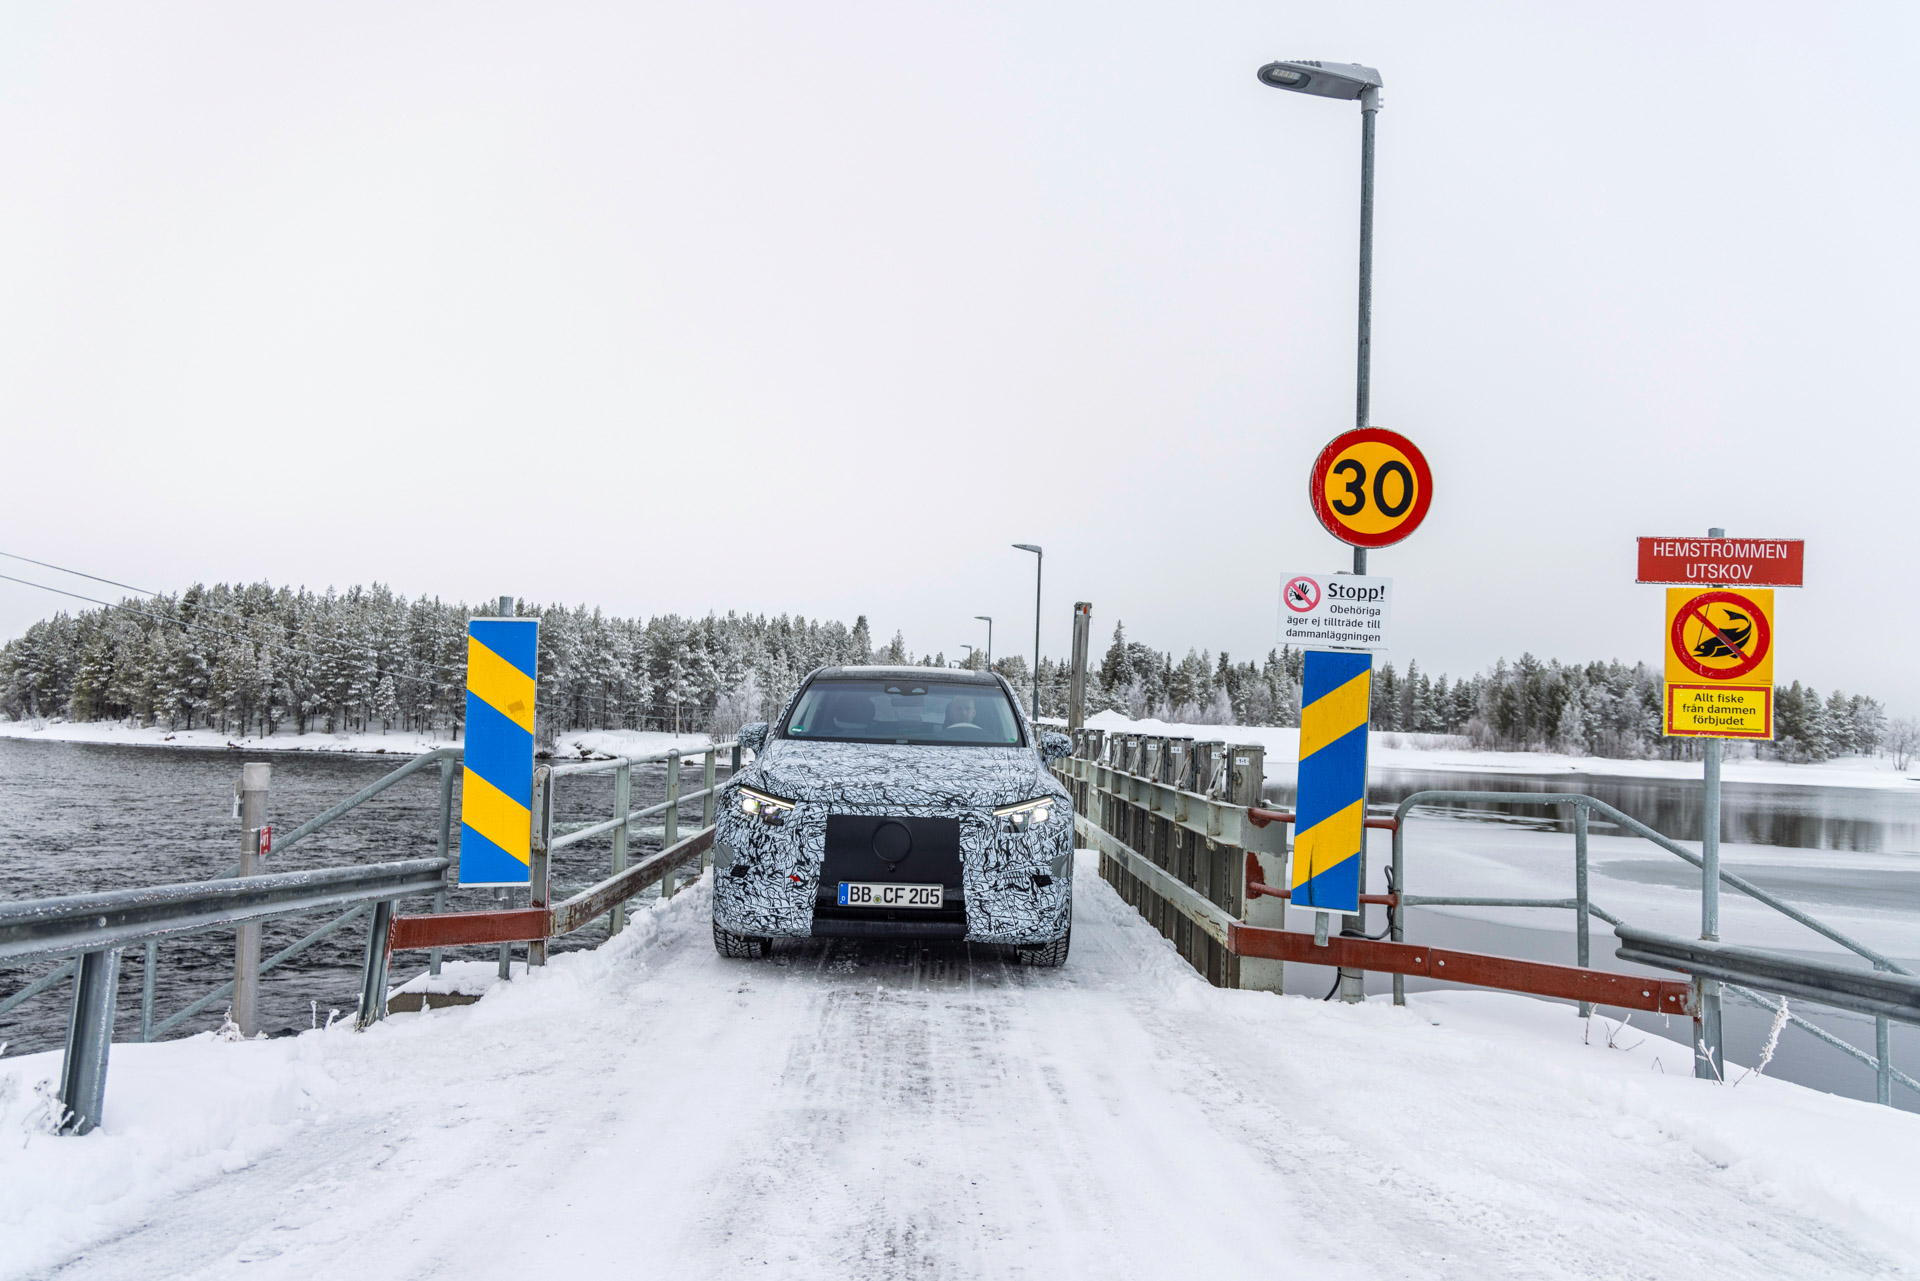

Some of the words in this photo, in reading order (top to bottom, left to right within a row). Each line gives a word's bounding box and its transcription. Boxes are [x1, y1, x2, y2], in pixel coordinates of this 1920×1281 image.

[1332, 458, 1414, 517] 30
[1653, 539, 1788, 559] HEMSTRÖMMEN
[1686, 563, 1754, 579] UTSKOV
[1328, 582, 1385, 602] Stopp!
[1330, 604, 1381, 617] Obehöriga
[1286, 615, 1309, 626] äger
[1311, 617, 1321, 627] ej
[1324, 617, 1364, 628] tillträde
[1367, 619, 1381, 629] till
[1286, 628, 1381, 643] dammanläggningen
[1694, 693, 1714, 703] Allt
[1717, 693, 1744, 703] fiske
[1682, 703, 1704, 713] från
[1707, 704, 1756, 715] dammen
[1693, 714, 1744, 726] förbjudet
[850, 886, 872, 902] BB
[883, 887, 906, 904] CF
[908, 888, 940, 905] 205
